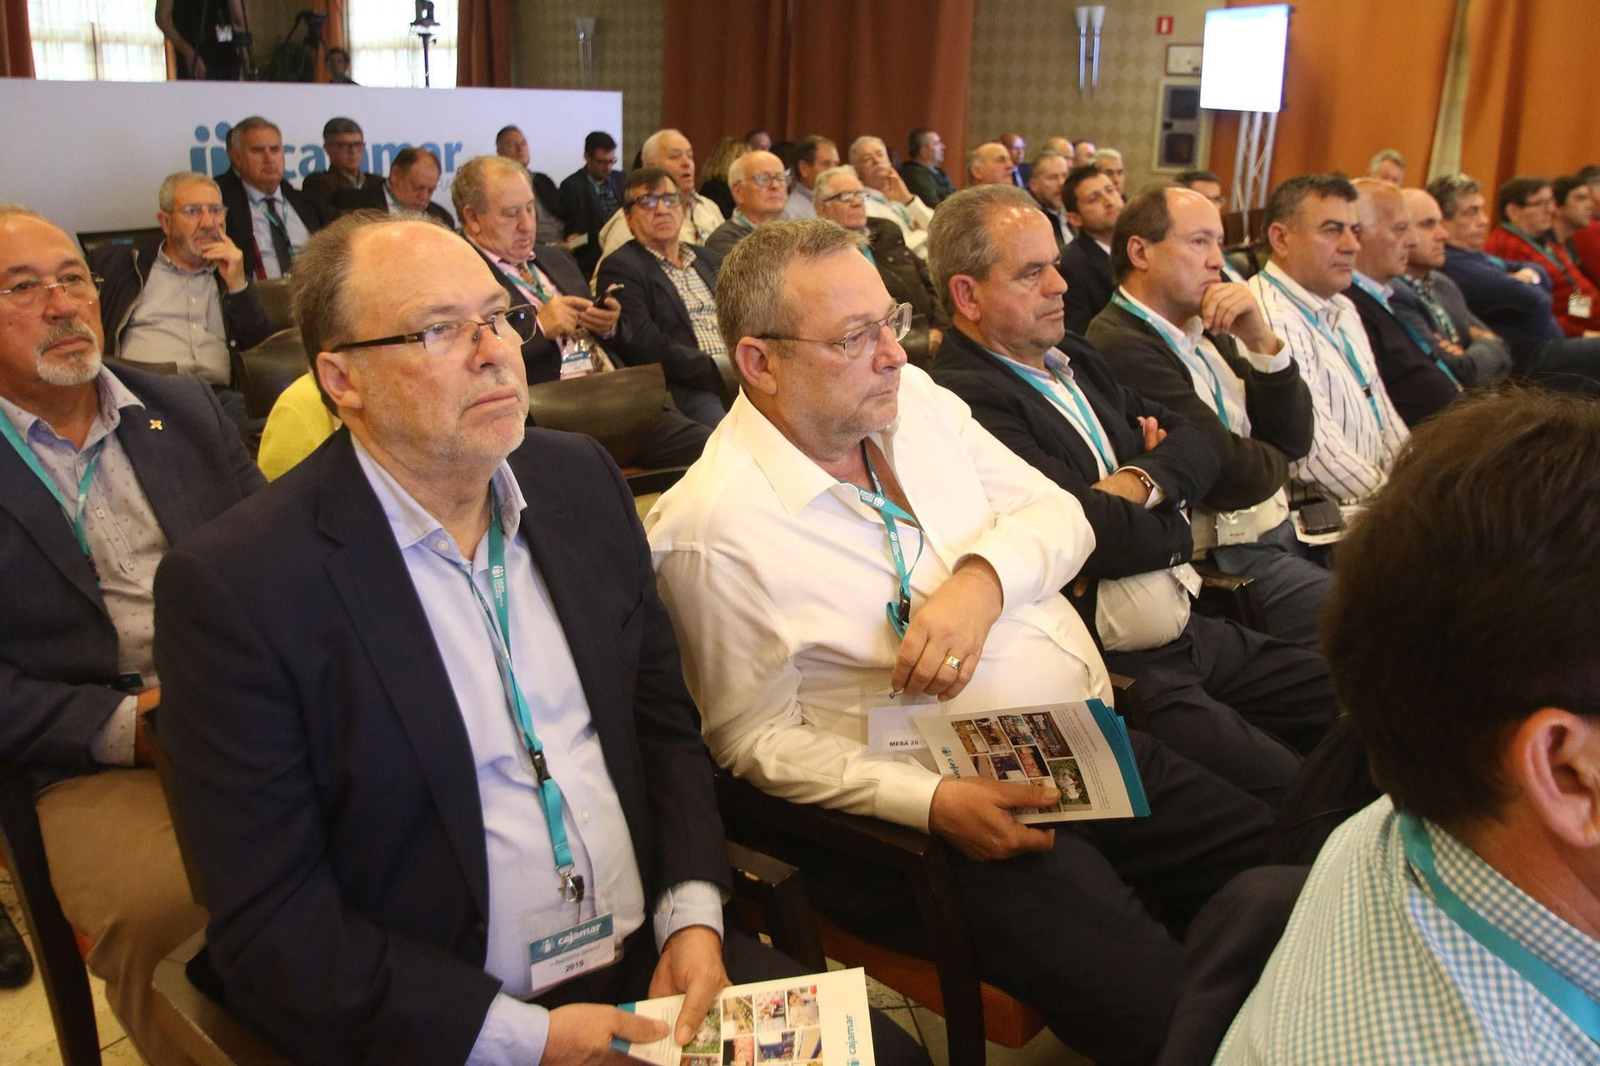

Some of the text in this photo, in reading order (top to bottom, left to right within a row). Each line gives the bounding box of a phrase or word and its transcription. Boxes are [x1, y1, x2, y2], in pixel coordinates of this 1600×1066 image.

[558, 923, 601, 945] cajamar
[565, 960, 584, 972] 2019
[845, 1014, 858, 1055] cajamar
